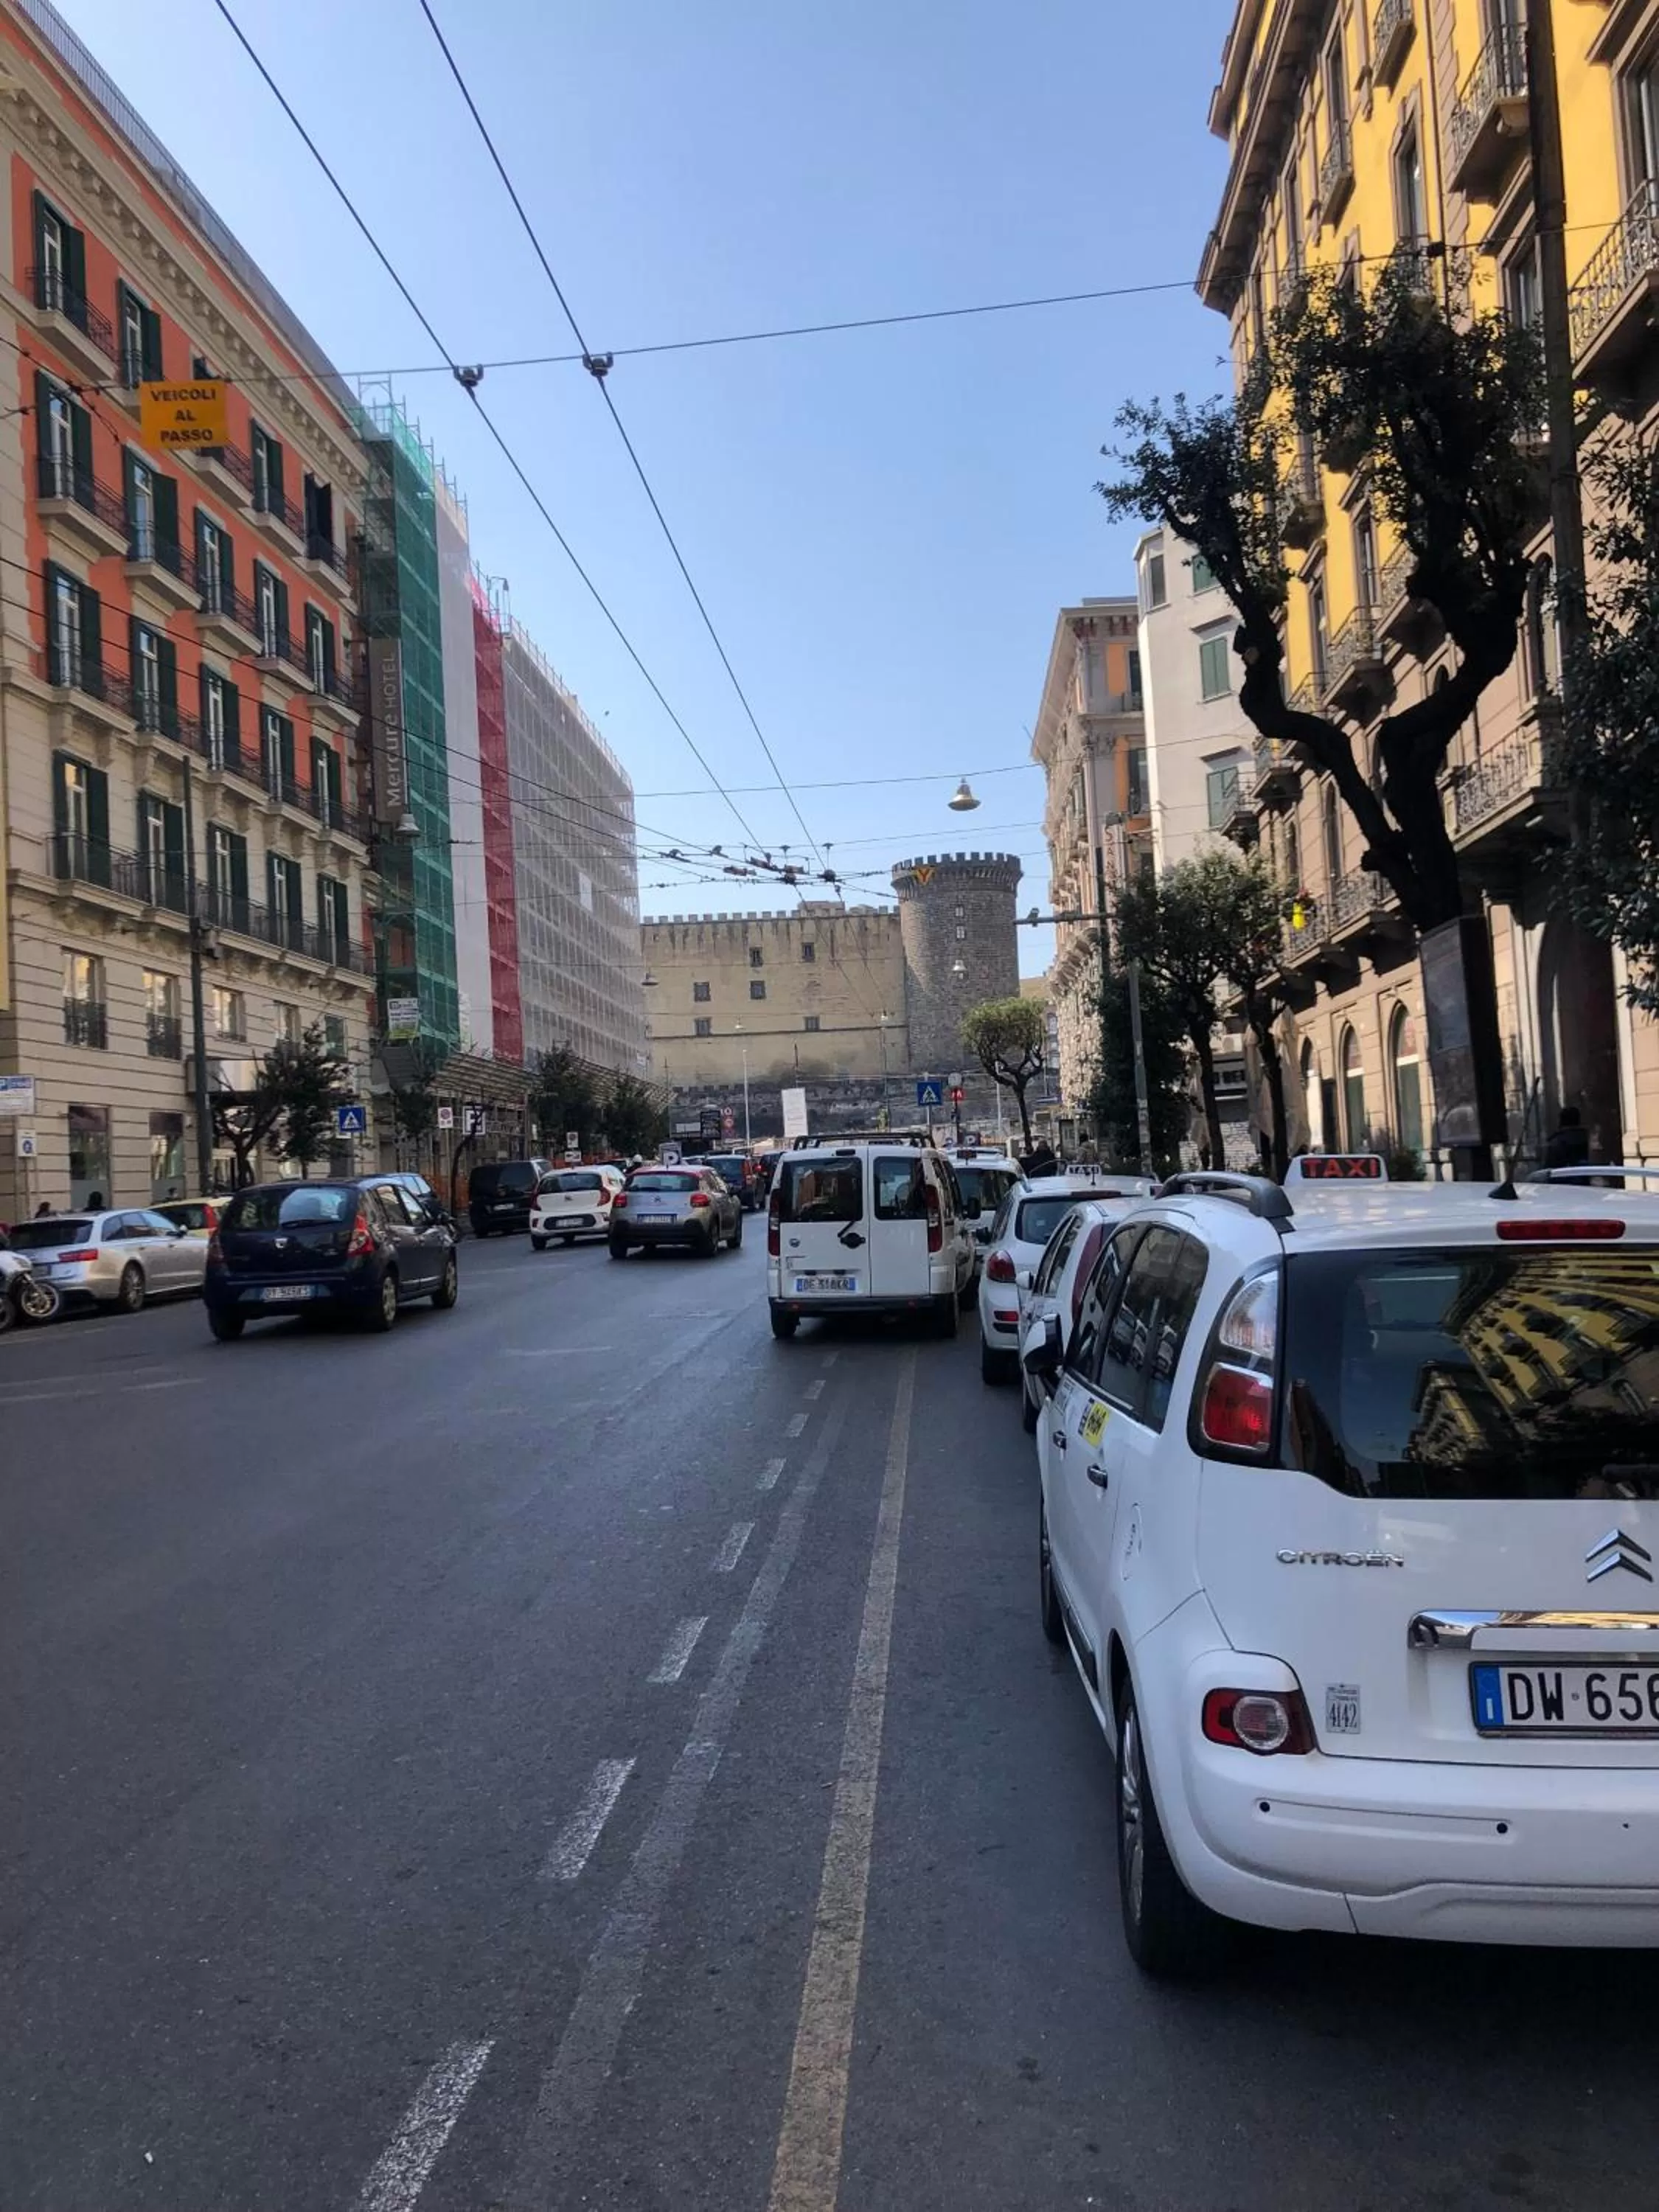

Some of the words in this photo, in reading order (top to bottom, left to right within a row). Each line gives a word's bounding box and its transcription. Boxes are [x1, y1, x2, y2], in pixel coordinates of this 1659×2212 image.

[151, 389, 216, 401] VEICOLI
[175, 409, 197, 422] AL
[160, 429, 213, 442] PASSO
[382, 653, 397, 709] HOTEL
[384, 714, 402, 807] Mercure
[1303, 1158, 1378, 1178] TAXI
[1276, 1547, 1405, 1568] CITROËN
[1507, 1672, 1565, 1722] DW
